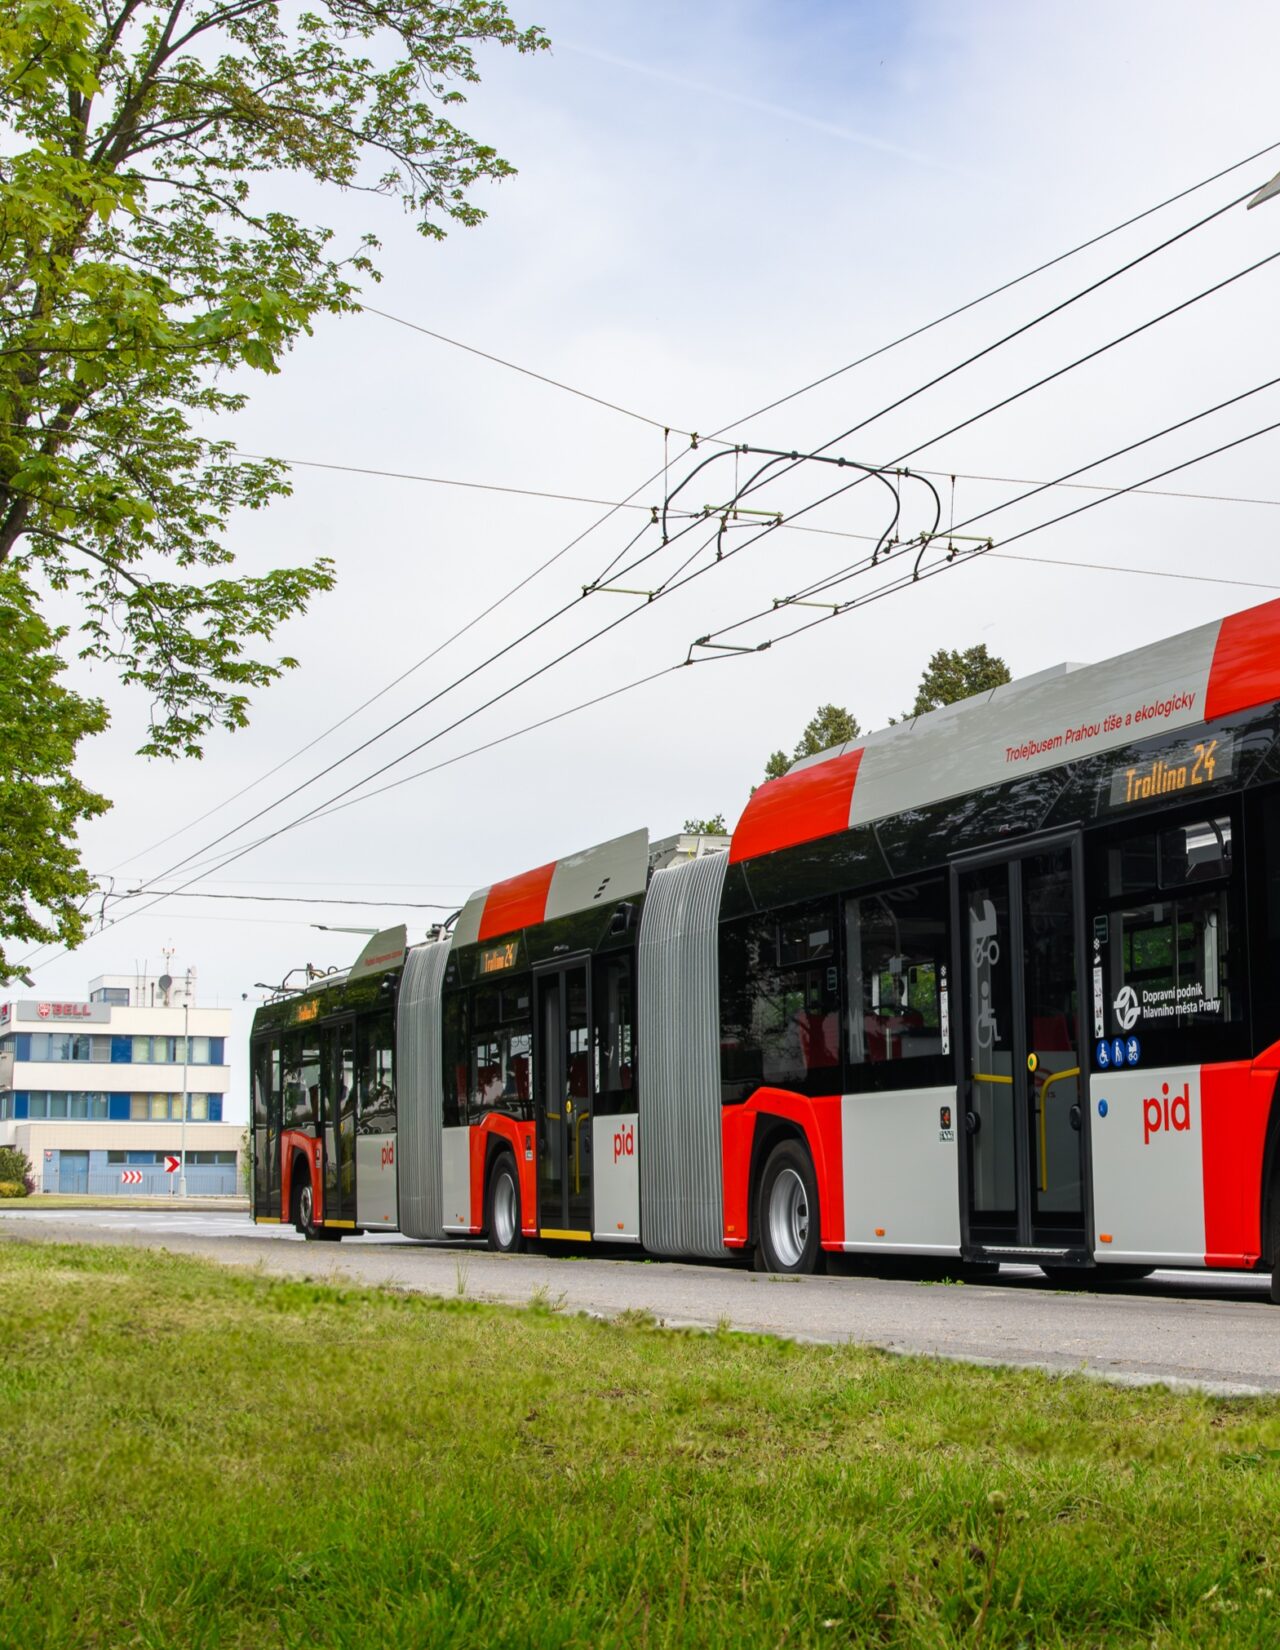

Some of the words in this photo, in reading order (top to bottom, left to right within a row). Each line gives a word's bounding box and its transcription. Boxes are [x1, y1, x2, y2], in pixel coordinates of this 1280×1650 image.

[1005, 734, 1062, 763] Trolejbusem
[1064, 723, 1100, 745] Prahou
[1103, 712, 1122, 733] tiše
[1125, 714, 1132, 727] a
[1134, 692, 1196, 723] ekologicky
[1126, 760, 1187, 802] Trollino
[1191, 740, 1218, 785] 24
[1143, 986, 1175, 1003] Dopravní
[1177, 982, 1203, 1001] podnik
[1143, 1002, 1174, 1019] hlavního
[1175, 1001, 1198, 1015] města
[1199, 999, 1221, 1014] Prahy
[1143, 1082, 1190, 1145] pid
[381, 1140, 394, 1171] pid
[614, 1123, 634, 1164] pid
